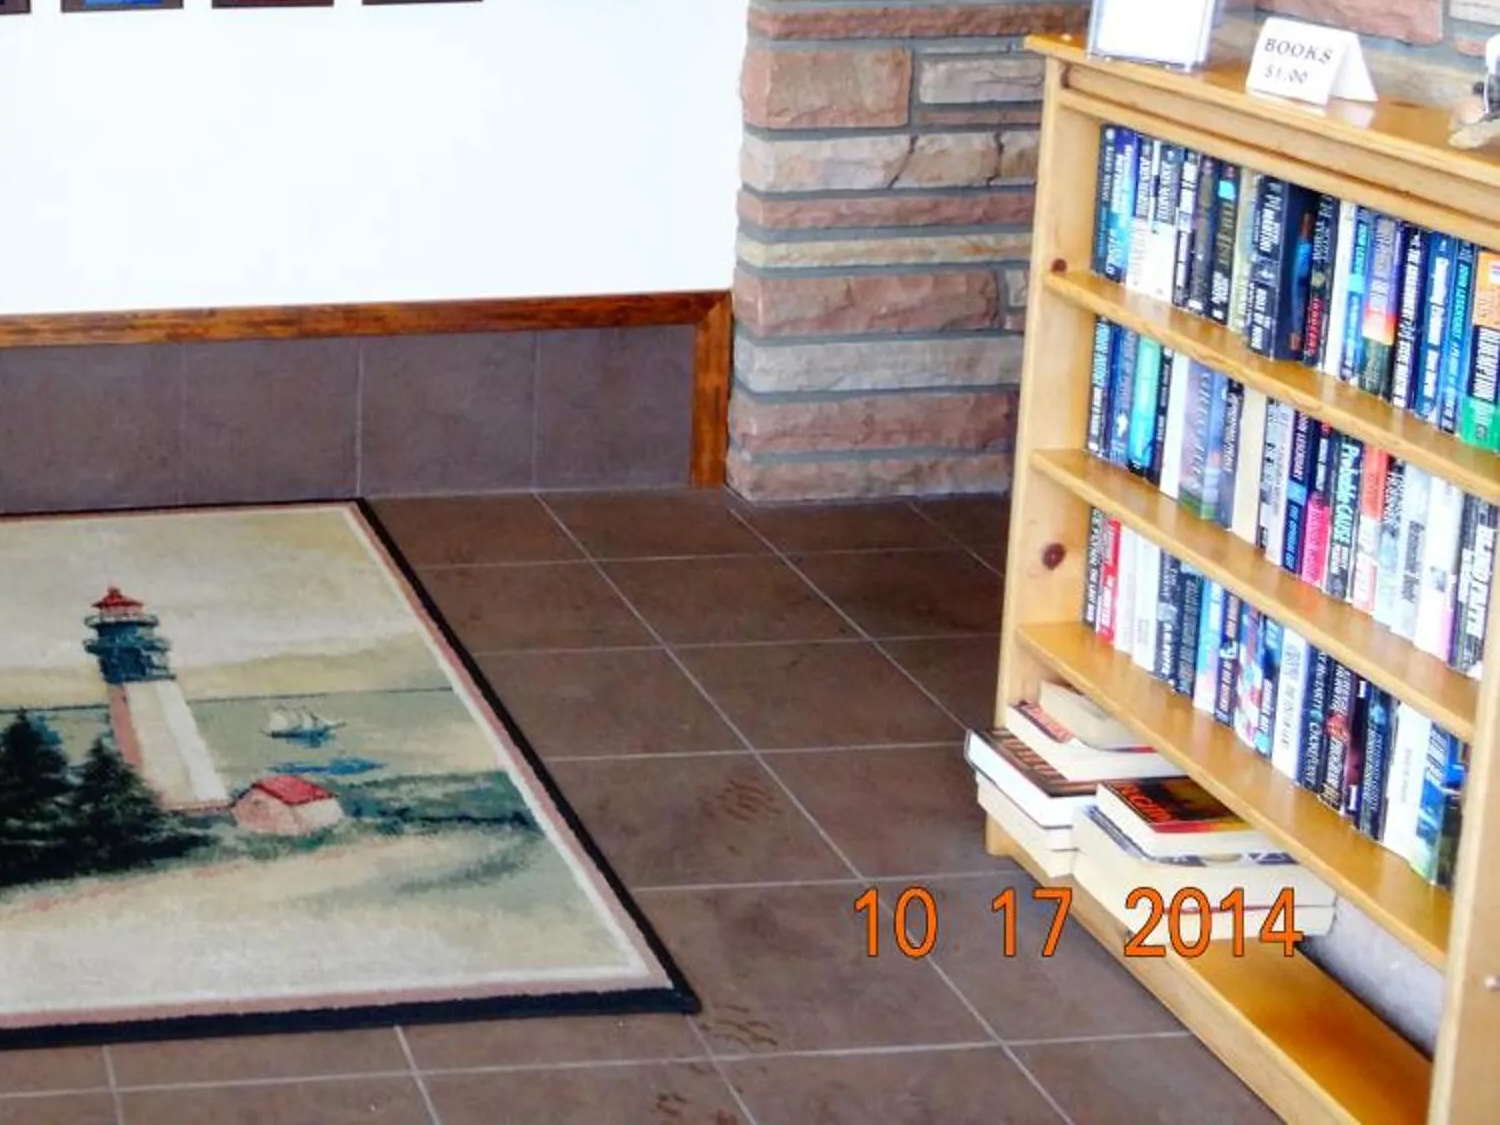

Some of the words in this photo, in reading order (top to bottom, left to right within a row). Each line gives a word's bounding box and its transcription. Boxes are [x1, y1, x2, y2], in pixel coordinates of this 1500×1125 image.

[1264, 38, 1333, 65] BOOKS
[1336, 443, 1360, 504] Probable
[1332, 504, 1354, 543] CAUSE
[1471, 525, 1494, 582] BLIND
[1465, 582, 1488, 639] FAITH
